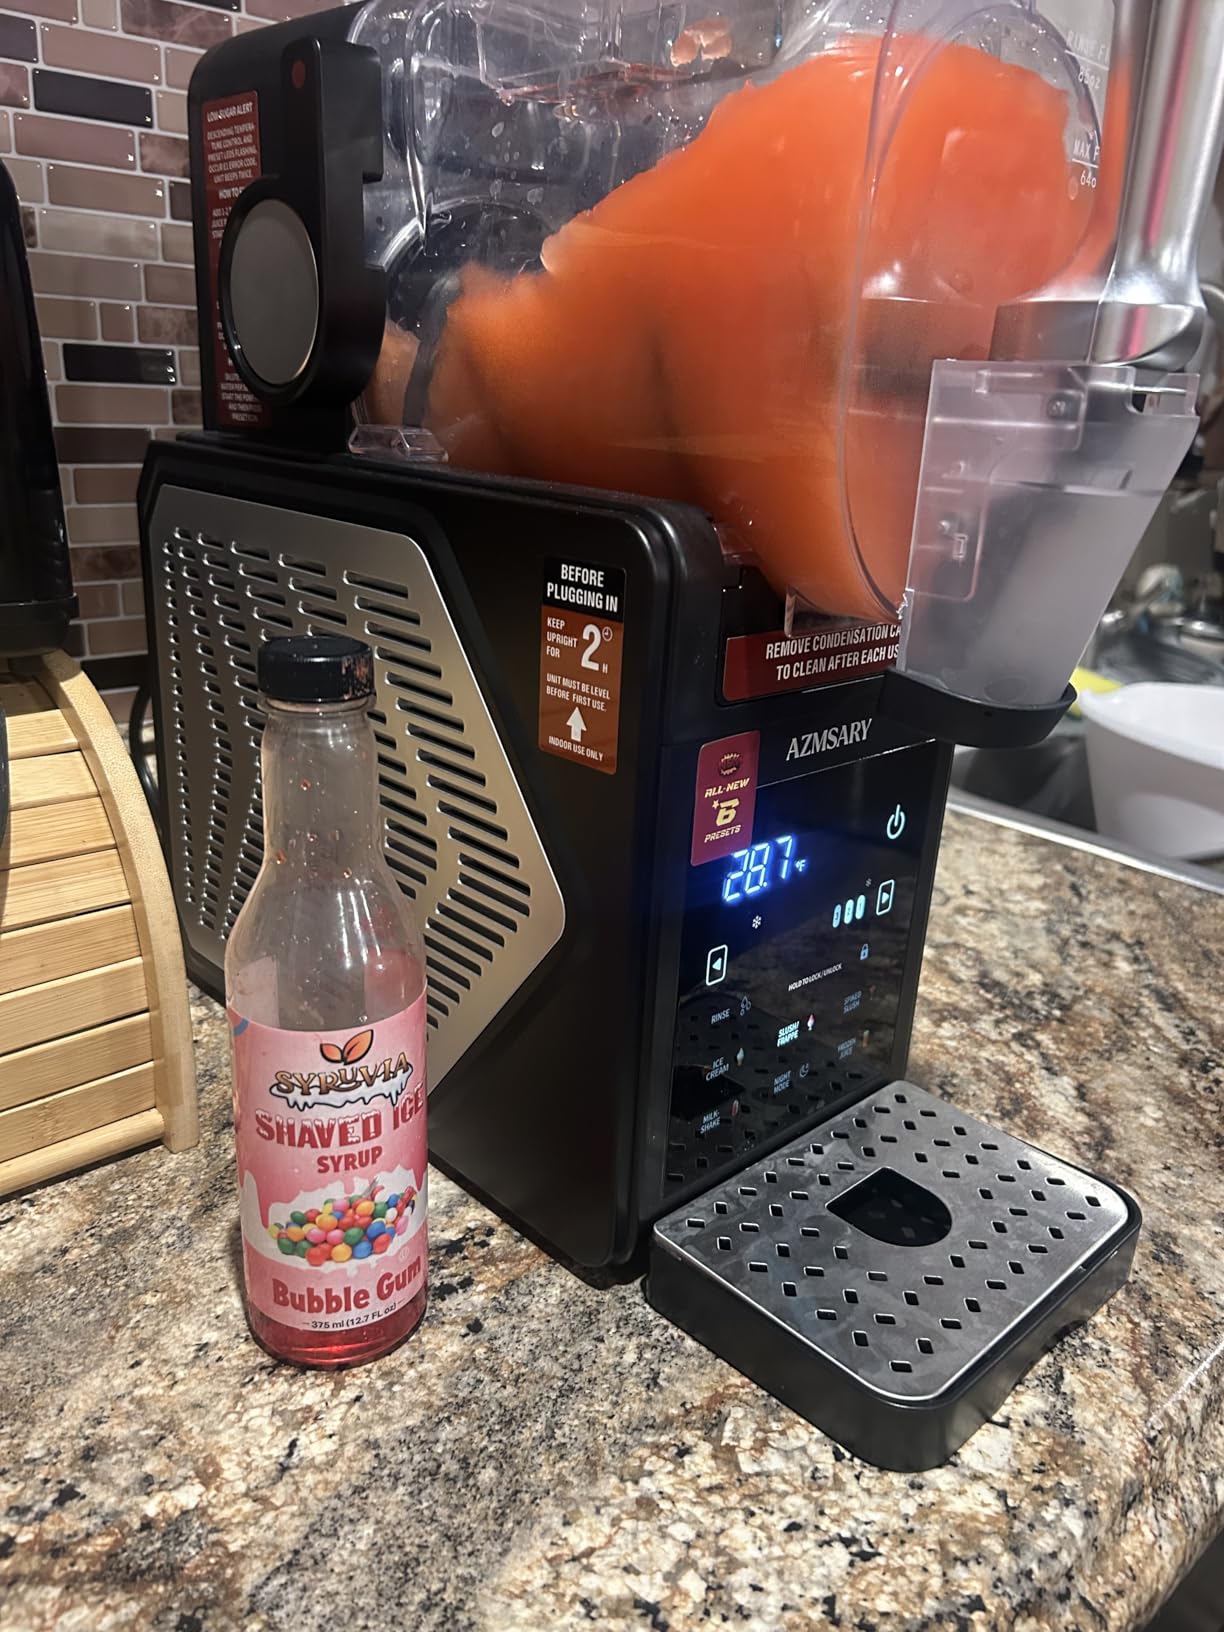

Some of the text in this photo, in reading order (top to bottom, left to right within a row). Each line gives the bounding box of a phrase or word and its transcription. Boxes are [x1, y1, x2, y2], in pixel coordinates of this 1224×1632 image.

[237, 102, 253, 115] ALERT
[1073, 139, 1091, 159] MAX
[561, 564, 604, 587] BEFORE
[547, 582, 618, 613] PLUGGING IN
[547, 617, 565, 630] KEEP
[547, 632, 578, 649] UPRIGHT
[581, 623, 602, 671] 2
[766, 634, 811, 660] REMOVE
[812, 625, 889, 652] CONDENSATION
[546, 646, 560, 658] FOR
[602, 664, 608, 674] H
[776, 664, 790, 681] TO
[792, 657, 826, 678] CLEAN
[827, 652, 860, 672] AFTER
[860, 646, 887, 665] EACH
[546, 673, 610, 700] UNIT MUST BE LEVEL
[546, 685, 607, 712] BEFORE FIRST USE.
[548, 736, 604, 762] INDOOR USE ONLY
[785, 718, 873, 762] AZMSARY
[704, 778, 750, 798] ALL-NEW
[715, 798, 740, 827] 6
[704, 825, 742, 843] PRESETS
[788, 980, 802, 992] HOLD
[710, 1008, 730, 1024] RINSE
[776, 1030, 799, 1047] FRAPPE
[705, 1062, 730, 1082] CREAM
[712, 1056, 724, 1070] ICE
[274, 1052, 410, 1097] SYRUVIA
[774, 1070, 792, 1086] NIGHT
[774, 1080, 790, 1094] MODE
[255, 1081, 424, 1149] SHAVED ICE
[702, 1110, 720, 1124] MILK-
[700, 1118, 720, 1134] SHAKE
[317, 1145, 383, 1174] SYRUP
[272, 1256, 422, 1315] Bubble Gum
[311, 1301, 399, 1330] 375 ml (12.7 FL oz)
